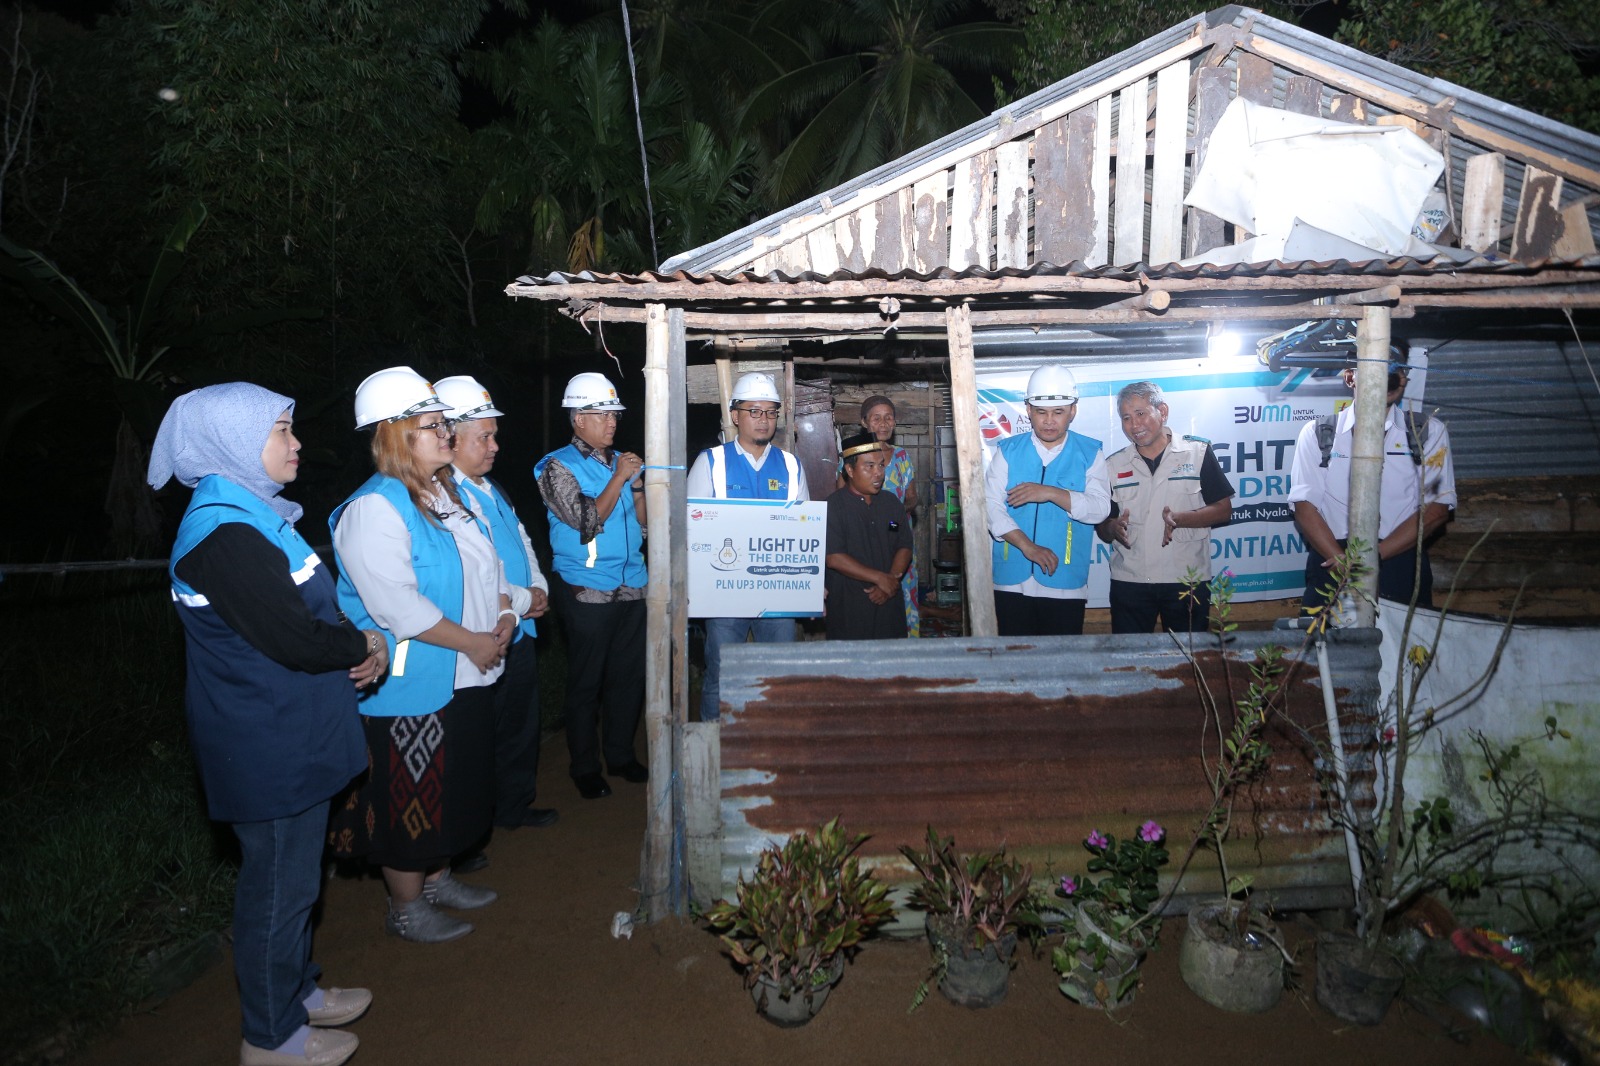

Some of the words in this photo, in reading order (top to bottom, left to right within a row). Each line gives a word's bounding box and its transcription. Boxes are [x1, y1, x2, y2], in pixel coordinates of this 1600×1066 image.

[1016, 414, 1031, 425] AS
[1212, 439, 1296, 474] GHT
[1239, 475, 1292, 498] DR
[1231, 509, 1251, 520] tuk
[1256, 507, 1289, 520] Nyala
[748, 537, 795, 552] LIGHT
[799, 539, 820, 552] UP
[1210, 534, 1310, 560] ONTIAN
[748, 553, 772, 563] THE
[775, 554, 819, 564] DREAM
[716, 579, 734, 590] PLN
[736, 580, 755, 590] UP3
[757, 580, 811, 590] PONTIANAK
